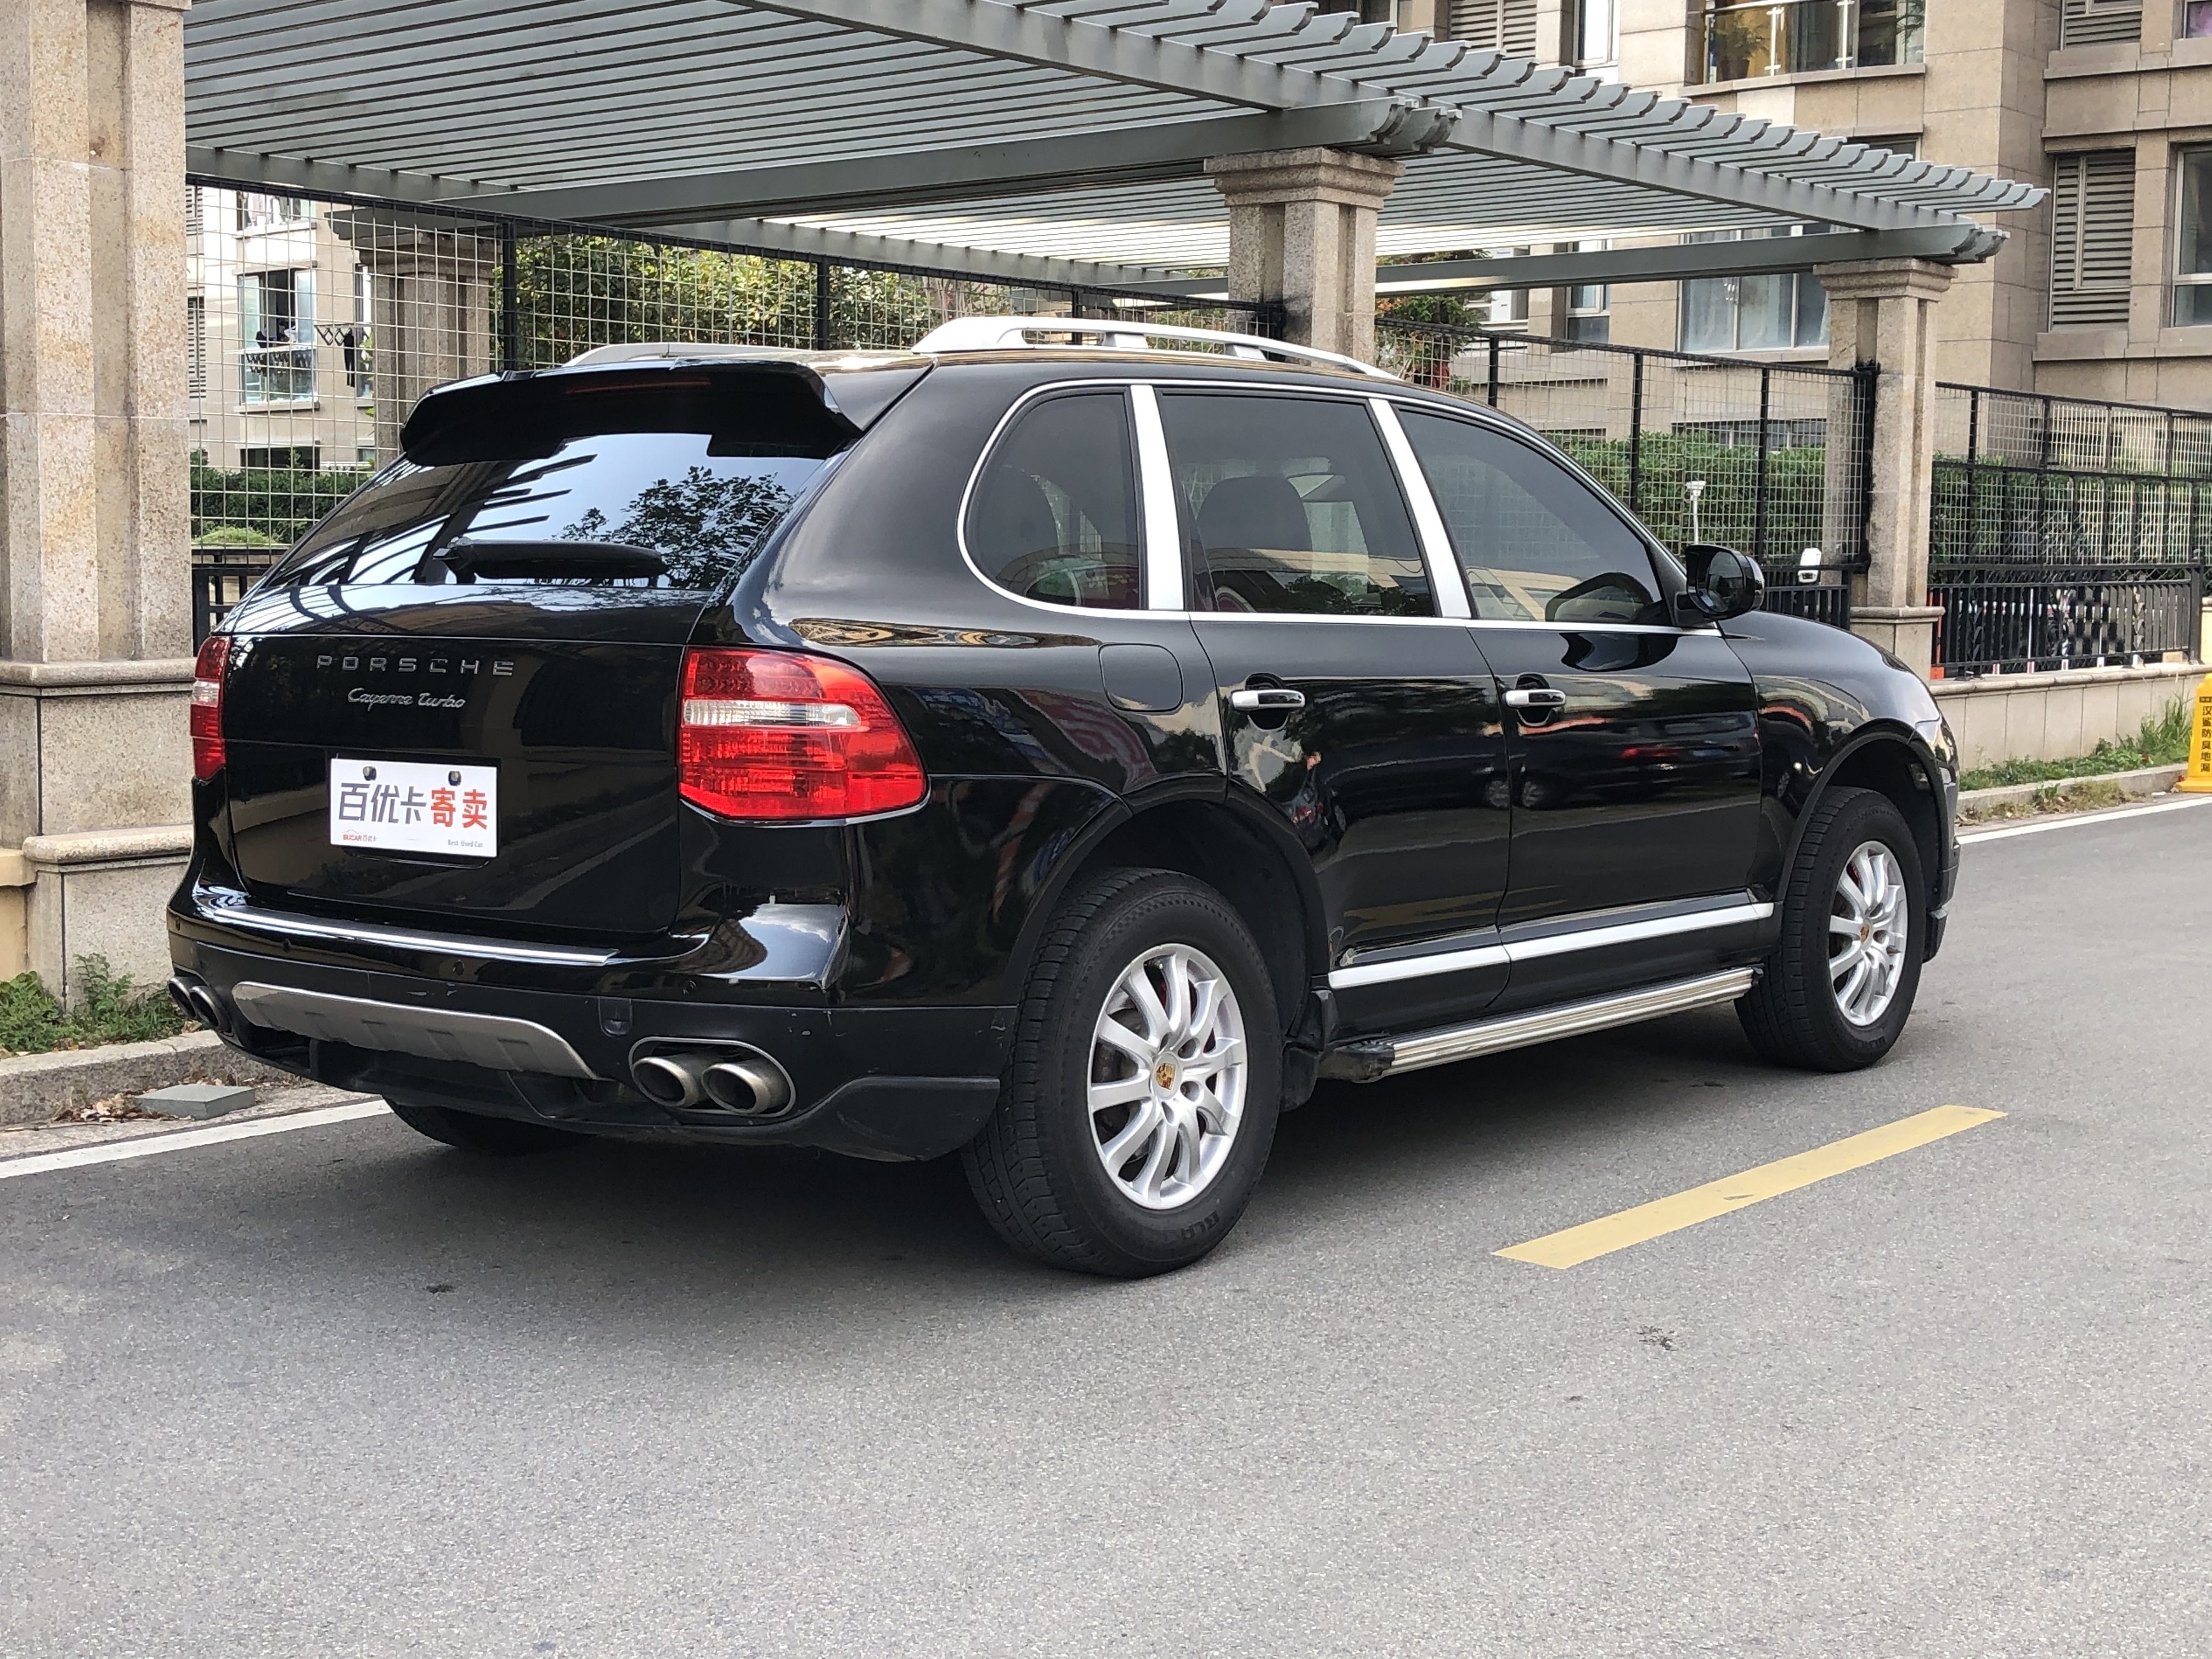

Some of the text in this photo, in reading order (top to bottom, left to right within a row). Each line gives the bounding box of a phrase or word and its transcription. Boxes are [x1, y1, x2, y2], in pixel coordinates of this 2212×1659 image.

[316, 654, 515, 676] PORSCHE
[347, 687, 413, 712] Cayenne
[338, 782, 488, 830] 百优卡寄卖
